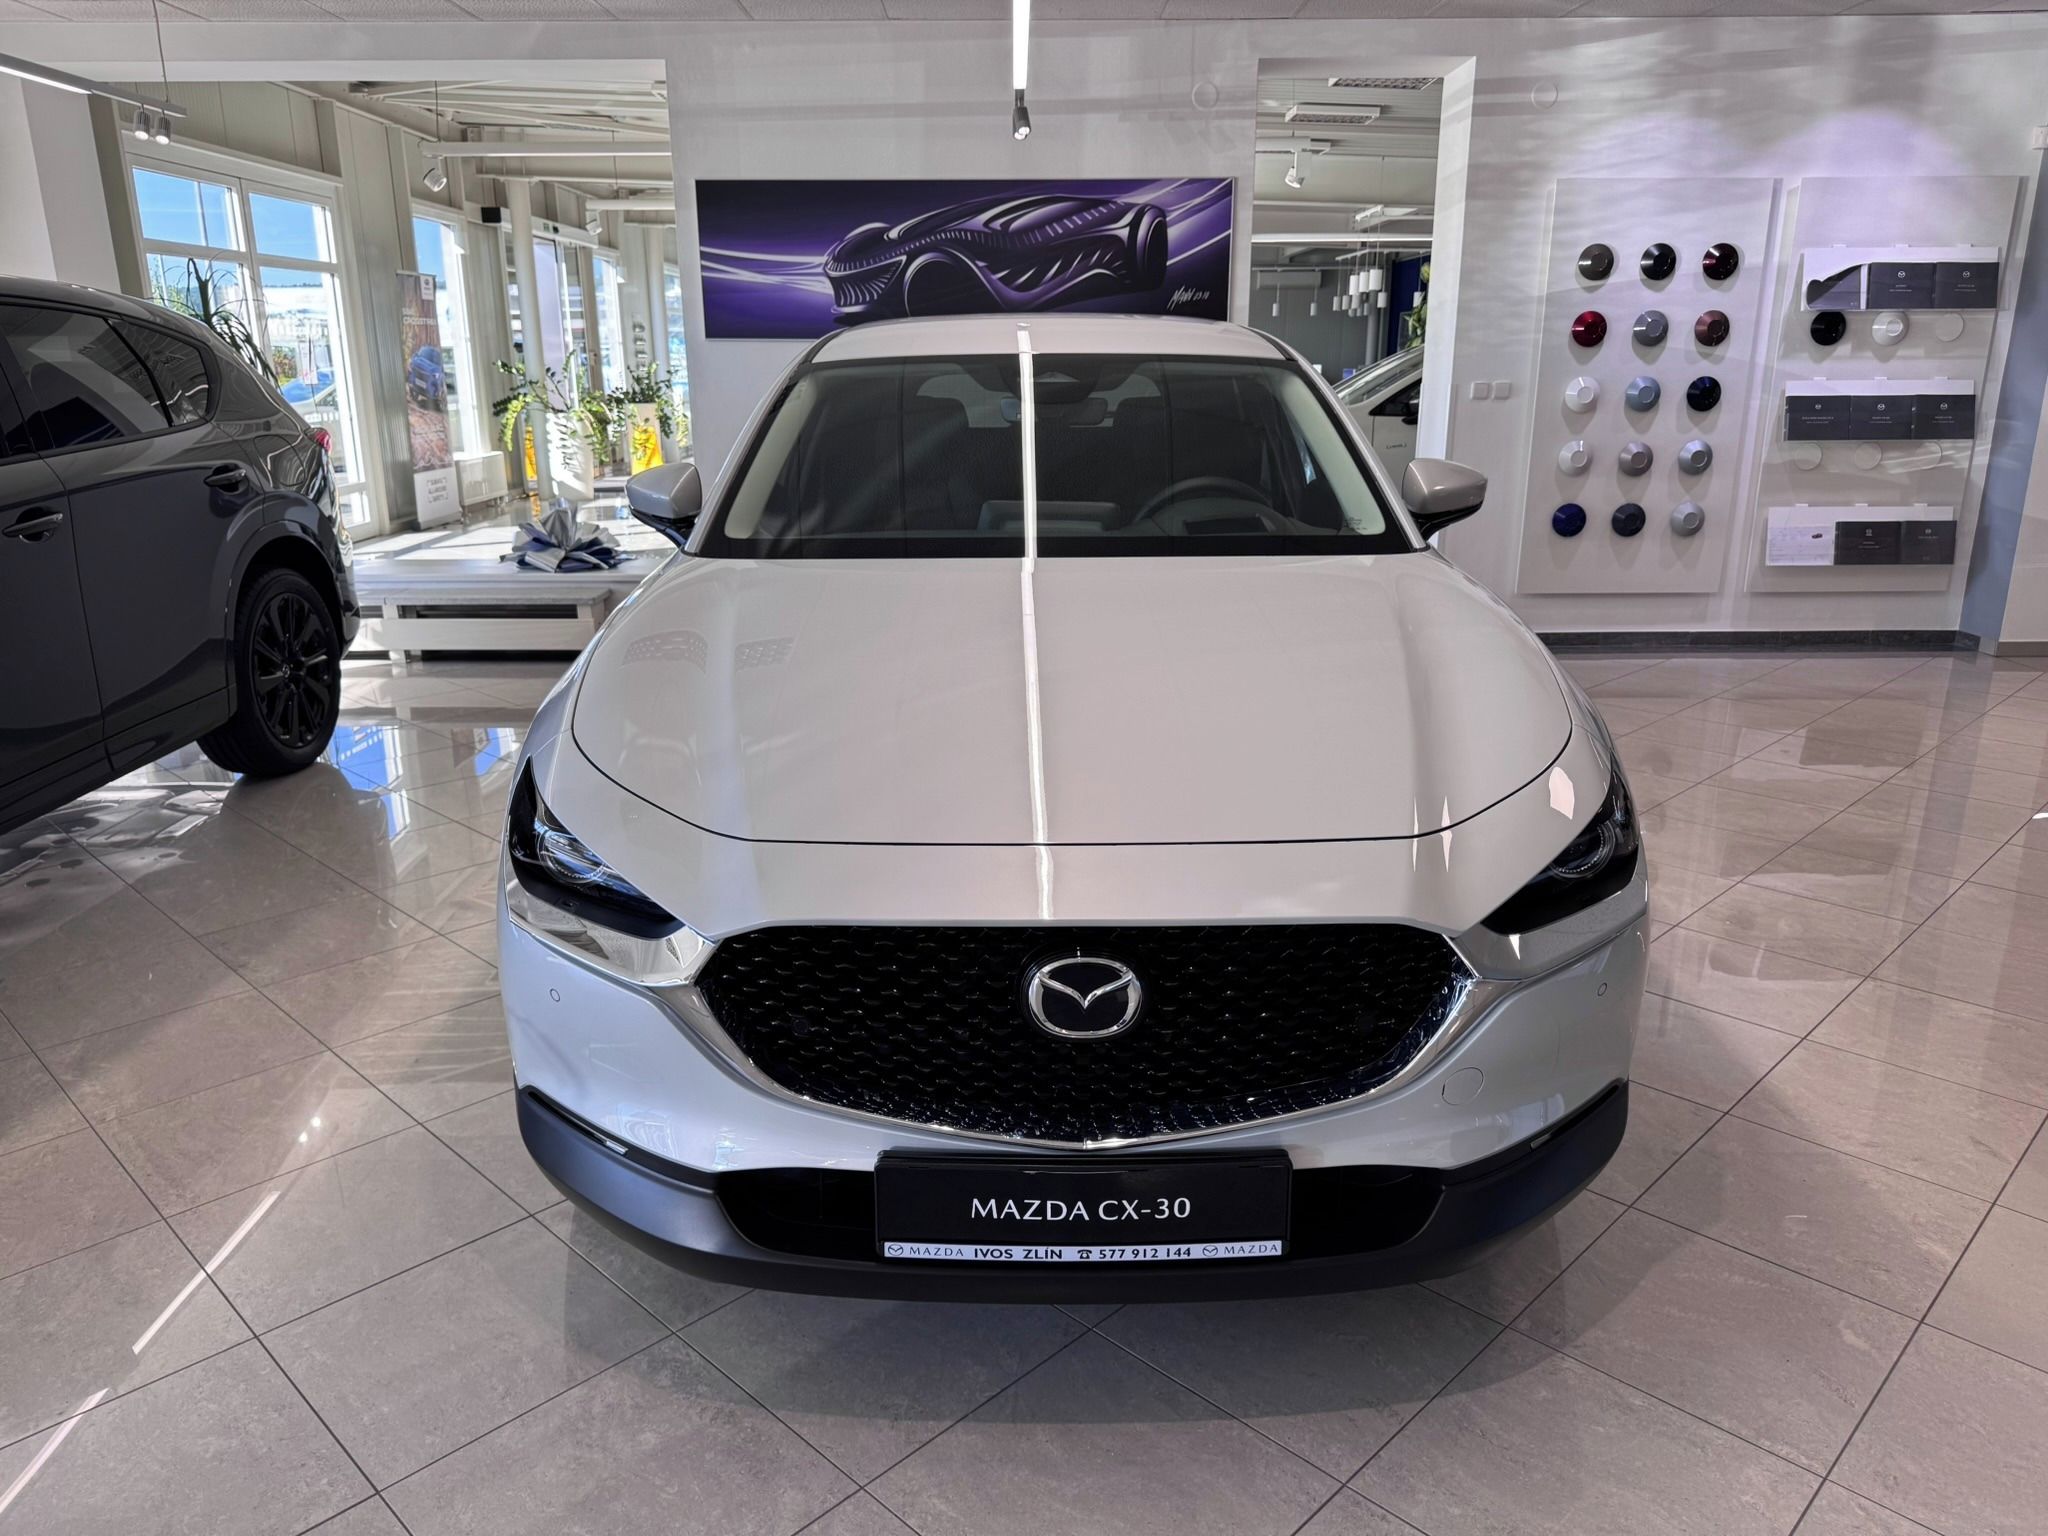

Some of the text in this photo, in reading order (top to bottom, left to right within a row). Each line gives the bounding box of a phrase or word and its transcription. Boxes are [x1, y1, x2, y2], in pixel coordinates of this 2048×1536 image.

[971, 1197, 1191, 1221] MAZDA CX-30
[909, 1244, 1279, 1260] MAZDA IVOS ZLÍN 577 912 144 MAZDA
